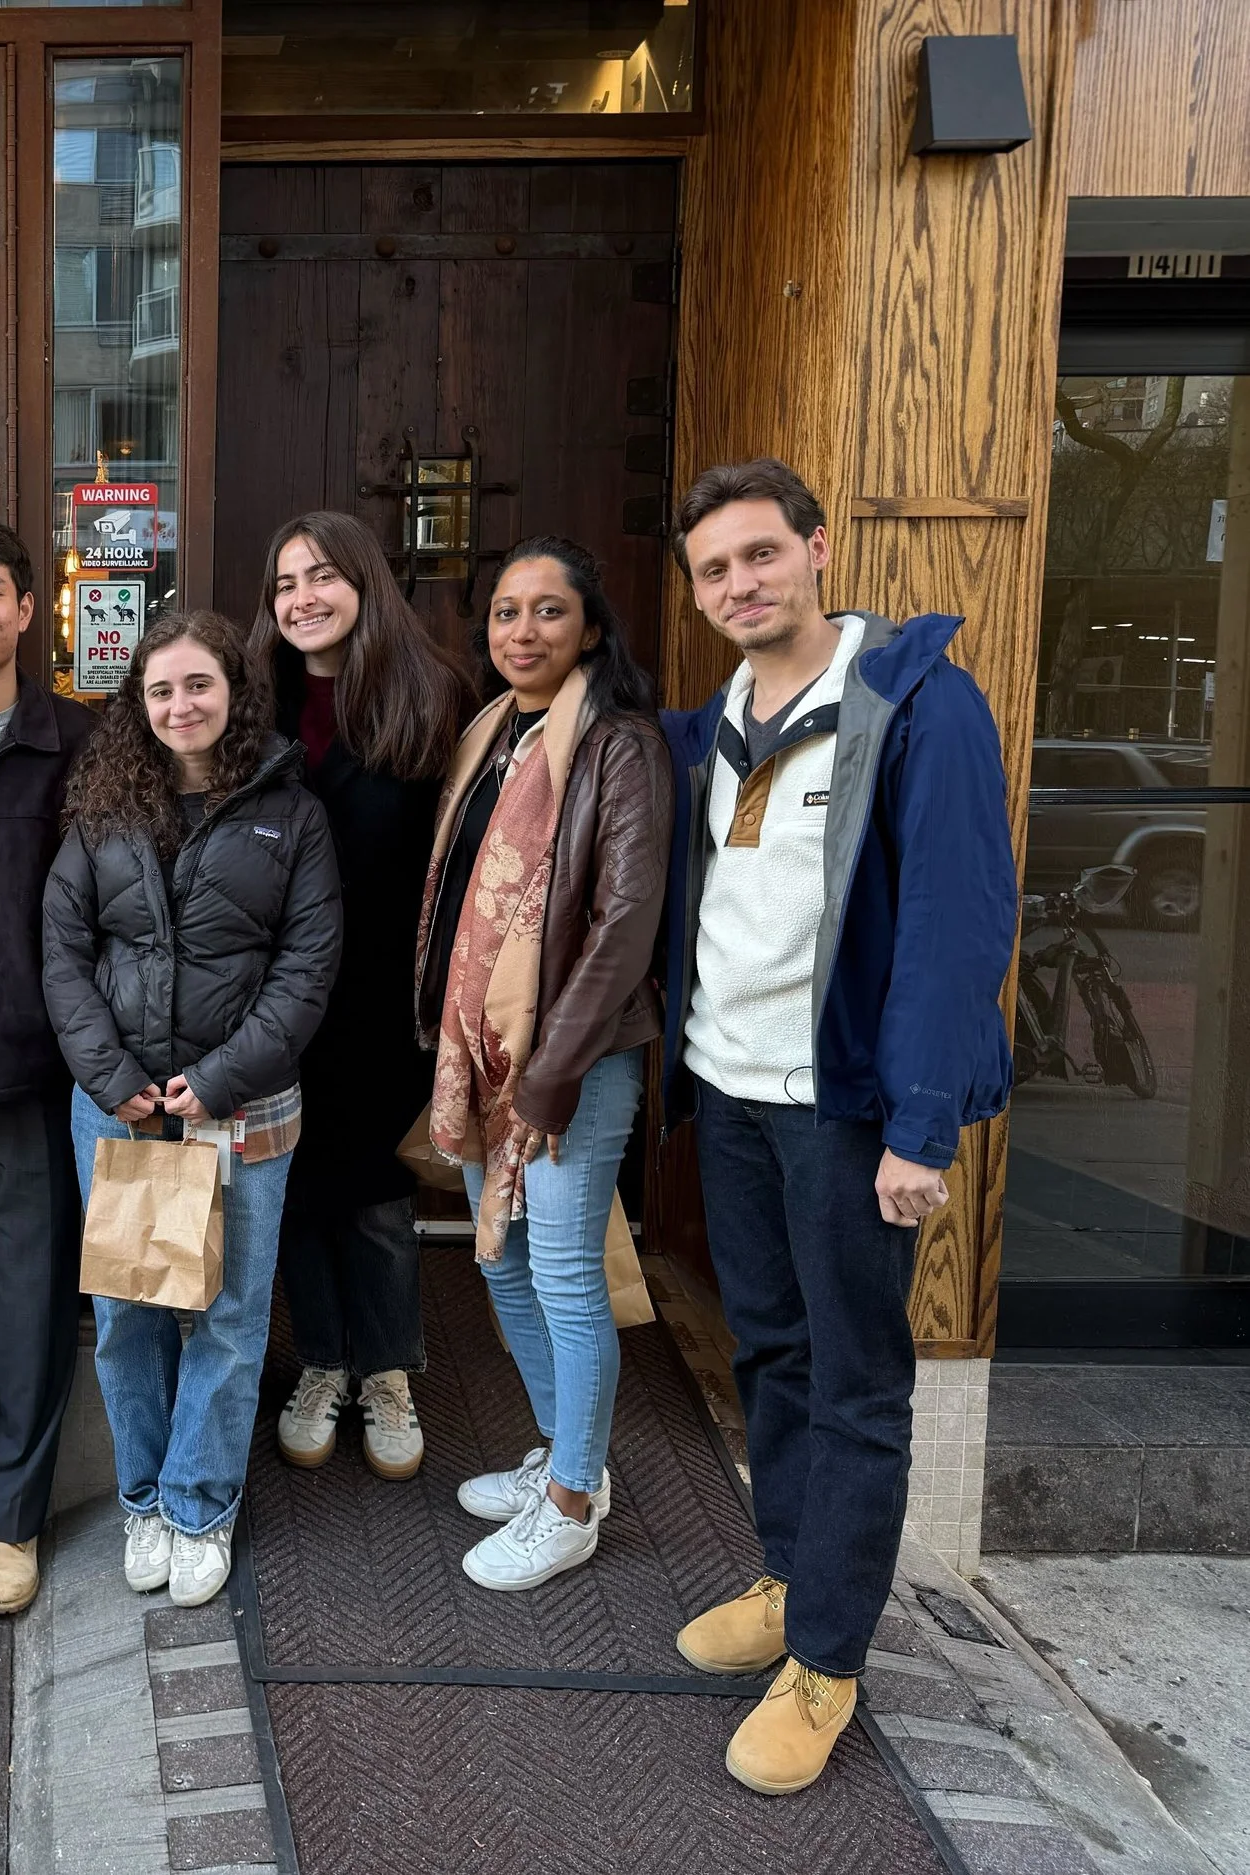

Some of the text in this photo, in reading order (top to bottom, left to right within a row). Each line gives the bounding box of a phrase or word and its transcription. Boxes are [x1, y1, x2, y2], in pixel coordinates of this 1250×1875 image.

[1137, 255, 1214, 275] 1411
[81, 489, 150, 501] WARNING
[85, 547, 144, 559] 24 HOUR
[97, 630, 121, 645] NO
[88, 647, 130, 661] PETS
